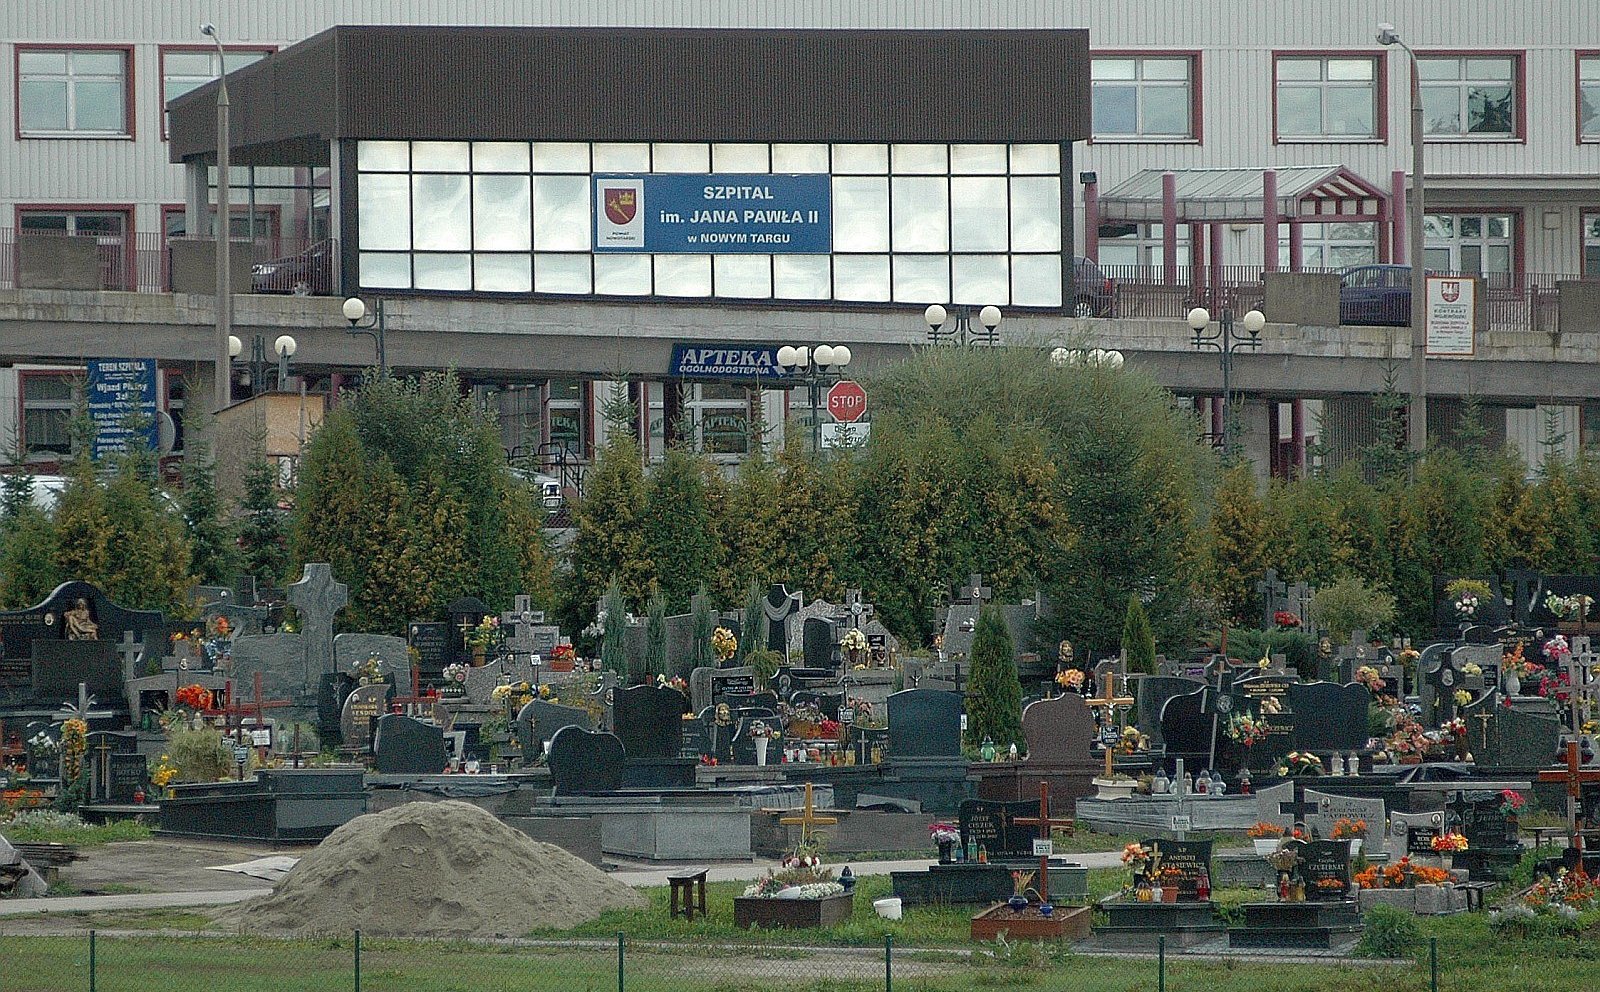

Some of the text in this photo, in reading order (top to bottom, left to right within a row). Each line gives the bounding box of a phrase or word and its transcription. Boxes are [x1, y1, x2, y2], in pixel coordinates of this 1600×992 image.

[703, 186, 774, 200] SZPITAL
[660, 210, 819, 224] im. JANA PAWŁA II
[687, 233, 791, 244] w NOWYM TARGU
[681, 348, 773, 366] APTEKA
[98, 363, 118, 371] TEREN
[679, 365, 770, 374] OGÓLNODOSTĘPNA
[97, 383, 120, 393] Wjazd
[831, 395, 863, 408] STOP
[551, 415, 578, 433] TEKA
[703, 415, 747, 433] APTEKA
